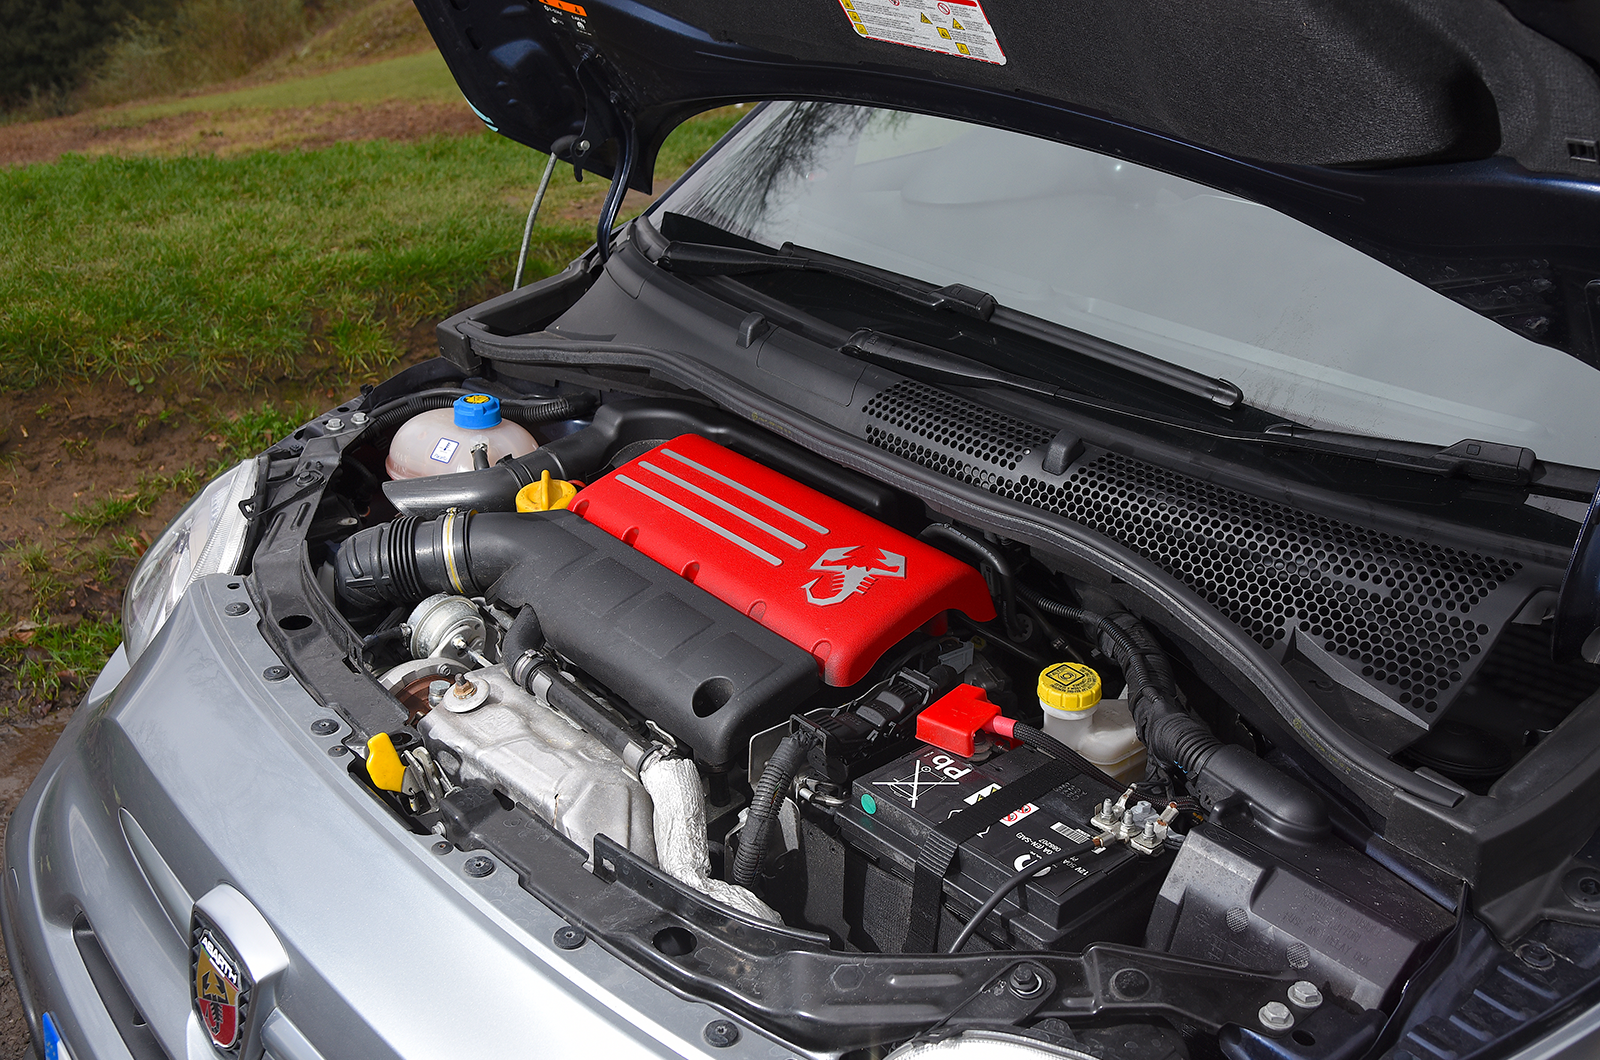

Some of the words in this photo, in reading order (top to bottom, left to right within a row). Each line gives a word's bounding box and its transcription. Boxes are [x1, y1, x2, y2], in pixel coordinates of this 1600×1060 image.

[932, 755, 972, 780] Pb
[1074, 866, 1089, 876] 12V
[201, 936, 238, 984] ABARTH
[1323, 934, 1353, 956] RELAY
[1353, 951, 1372, 967] BOX
